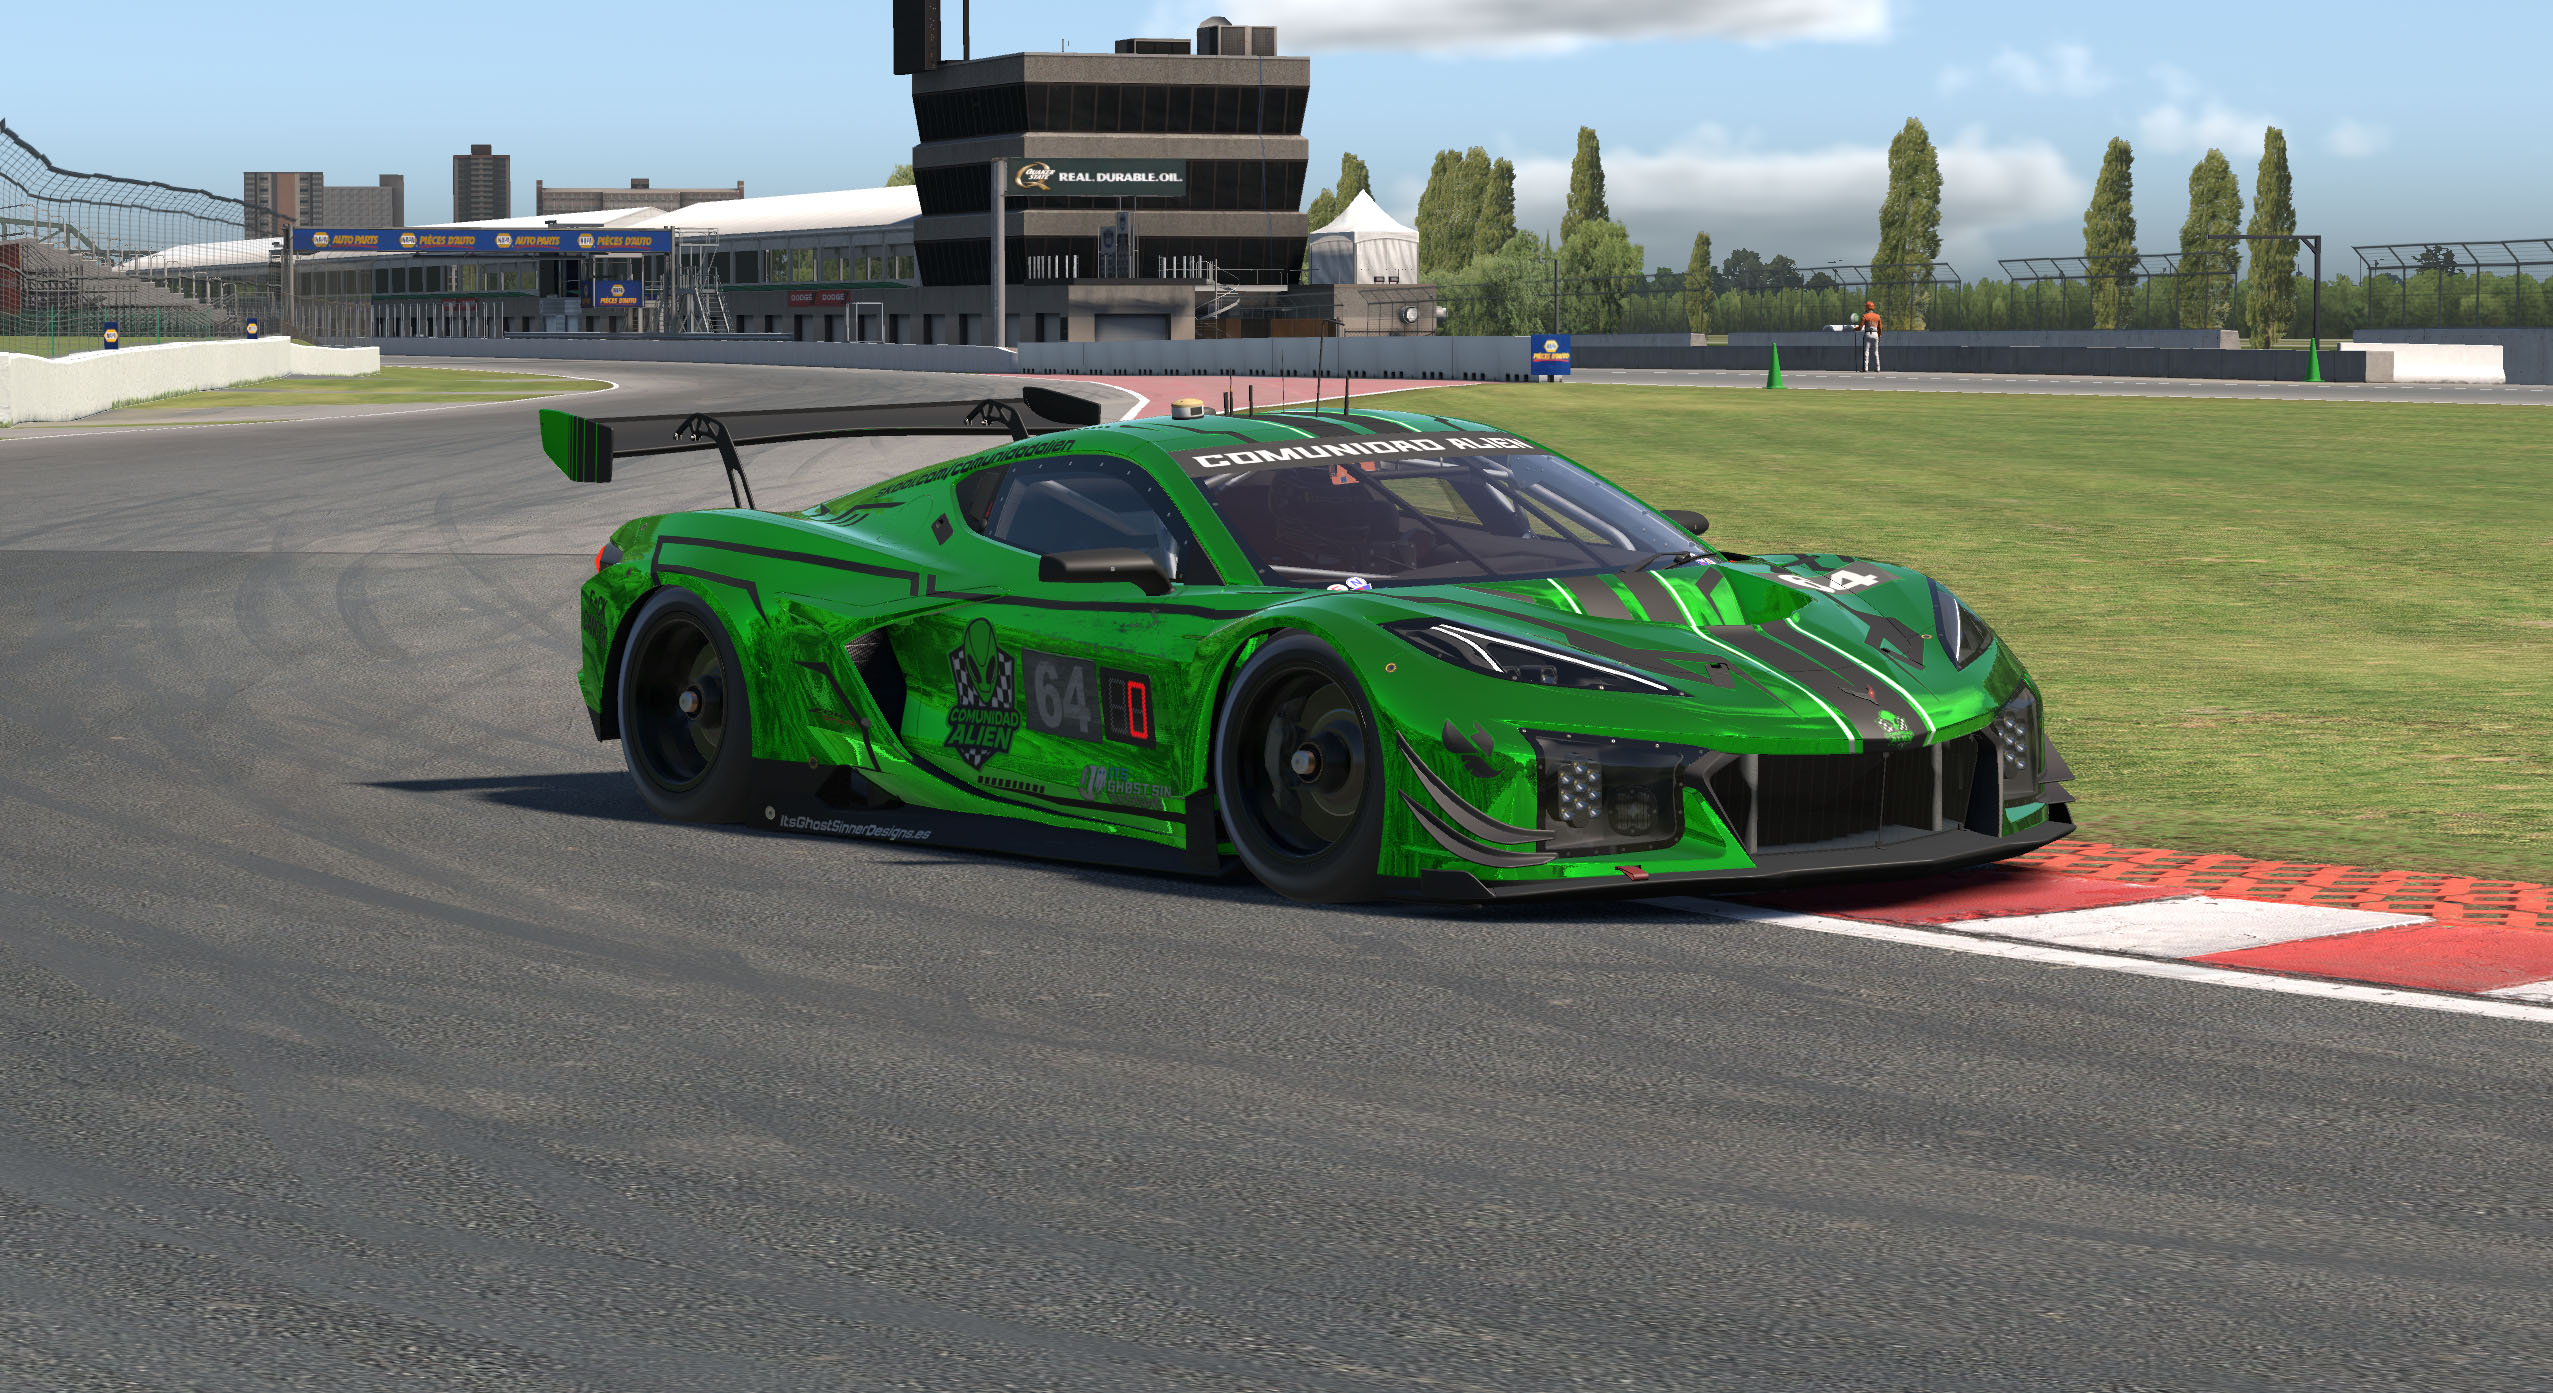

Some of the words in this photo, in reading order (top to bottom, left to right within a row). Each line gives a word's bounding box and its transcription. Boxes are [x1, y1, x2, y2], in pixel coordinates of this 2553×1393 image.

[332, 235, 354, 245] AUTO
[354, 235, 379, 245] PARTS
[419, 233, 446, 245] PIÈCES
[447, 235, 476, 245] D'AUTO
[514, 236, 536, 246] AUTO
[536, 236, 561, 246] PARTS
[597, 234, 623, 246] PIÈCES
[624, 236, 652, 246] D'AUTO
[1191, 438, 1447, 469] COMUNIDAD
[1445, 436, 1534, 451] ALIEN
[1777, 569, 1880, 594] 64
[1034, 661, 1092, 733] 64
[950, 707, 1019, 727] COMUNIDAD
[1127, 680, 1148, 740] 0
[947, 723, 1012, 750] ALIEN
[1108, 767, 1129, 780] ITS
[779, 814, 932, 841] ItsGhostSinnerDesigns.es
